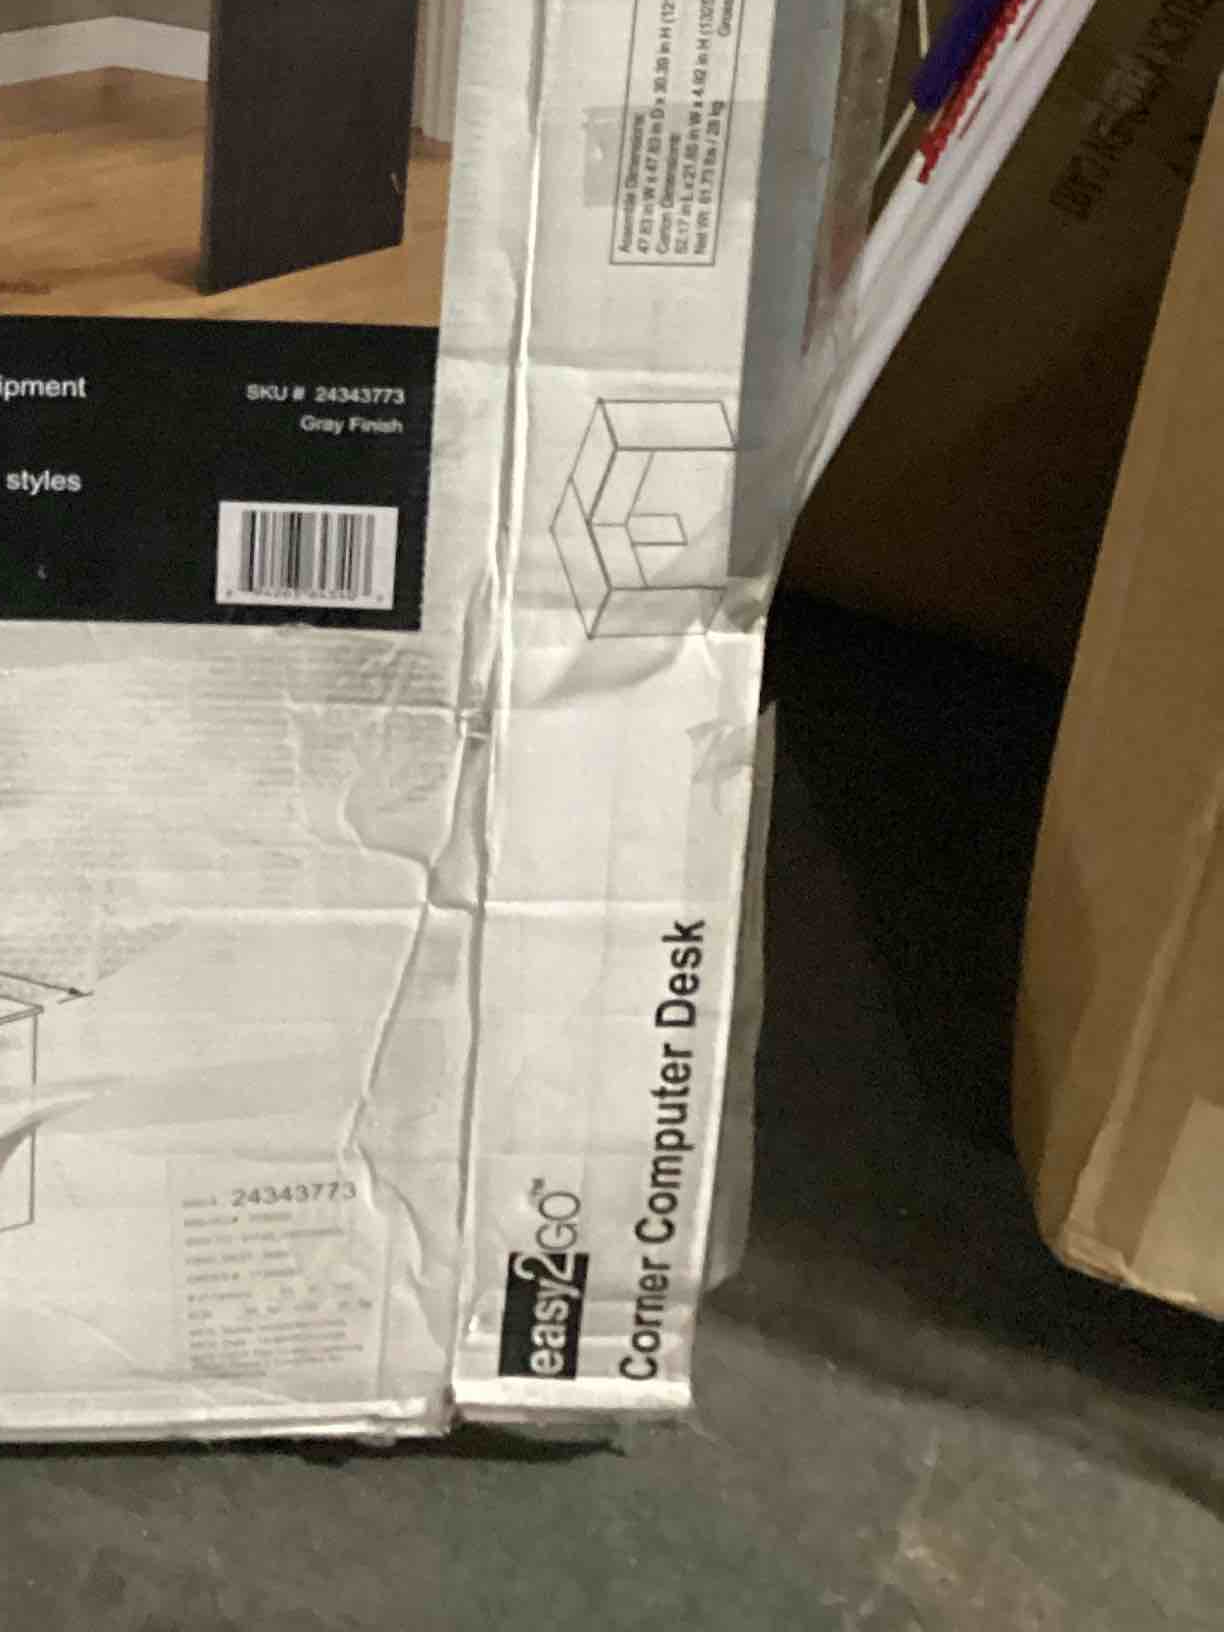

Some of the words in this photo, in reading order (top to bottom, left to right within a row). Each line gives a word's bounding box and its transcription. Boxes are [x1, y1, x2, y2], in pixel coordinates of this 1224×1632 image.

[247, 384, 287, 402] SKU
[314, 386, 406, 406] 24343773
[300, 415, 344, 436] Gray
[349, 415, 403, 435] Finish
[6, 468, 82, 494] styles
[655, 919, 706, 1030] Desk
[636, 1043, 695, 1245] Computer
[231, 1181, 358, 1208] 24343773
[620, 1256, 672, 1381] Corner
